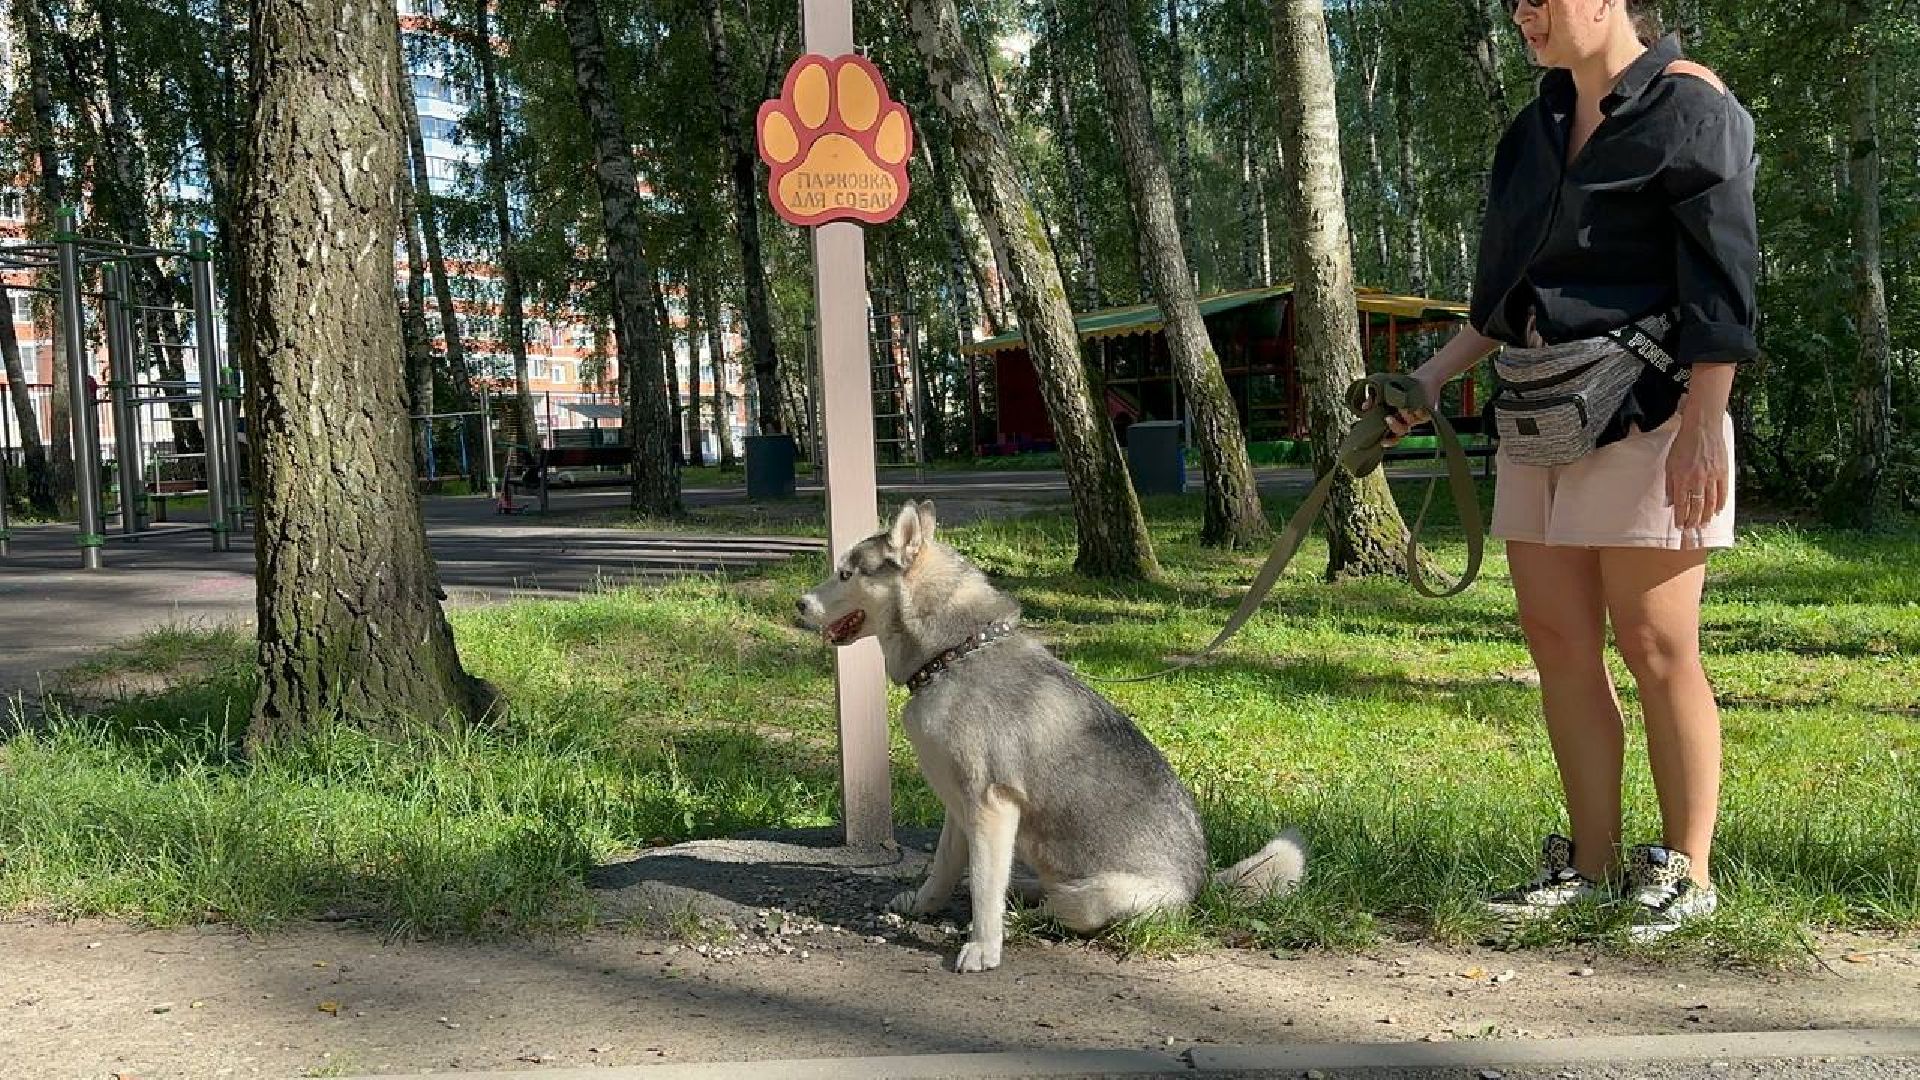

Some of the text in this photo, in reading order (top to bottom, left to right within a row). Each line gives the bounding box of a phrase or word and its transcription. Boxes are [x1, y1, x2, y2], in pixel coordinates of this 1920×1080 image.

[798, 172, 892, 190] ПАРКОВКА
[791, 192, 892, 208] ДЛЯ СОБАК
[1628, 332, 1674, 373] PINK
